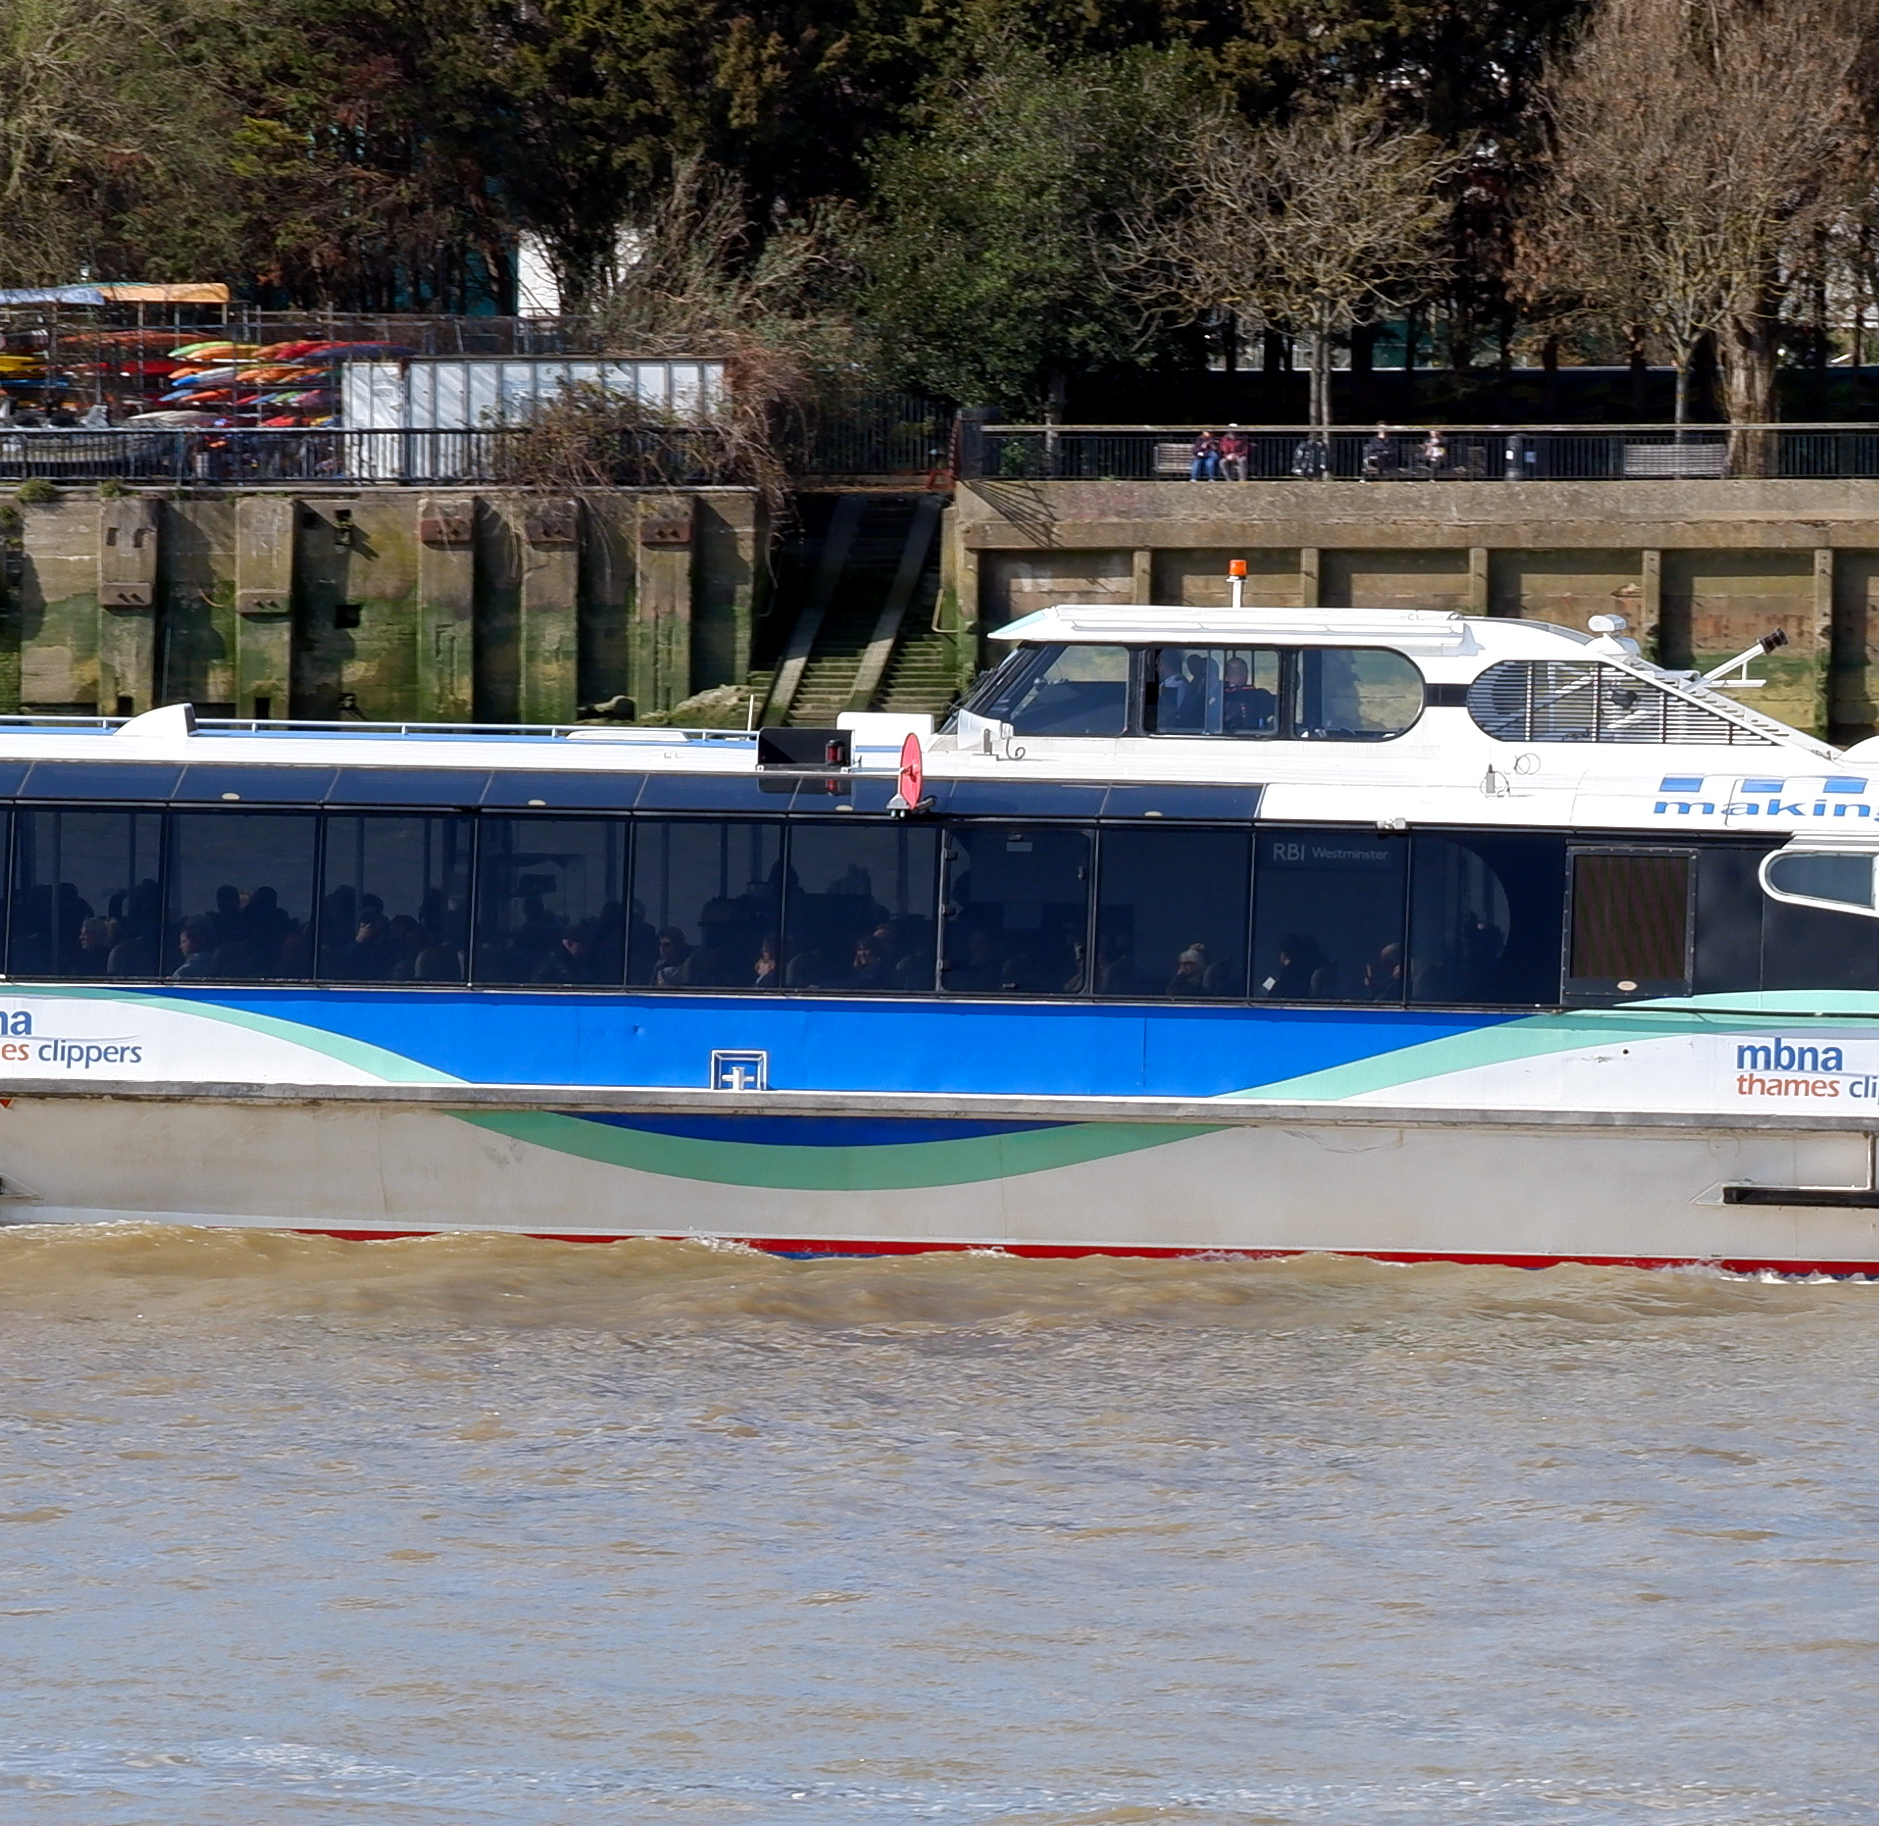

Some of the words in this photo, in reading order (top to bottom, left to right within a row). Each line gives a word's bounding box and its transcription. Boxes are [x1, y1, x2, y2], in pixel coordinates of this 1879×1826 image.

[1312, 847, 1389, 860] Westminster
[38, 1040, 143, 1069] clippers
[1737, 1037, 1843, 1071] mbna
[1737, 1073, 1840, 1097] thames
